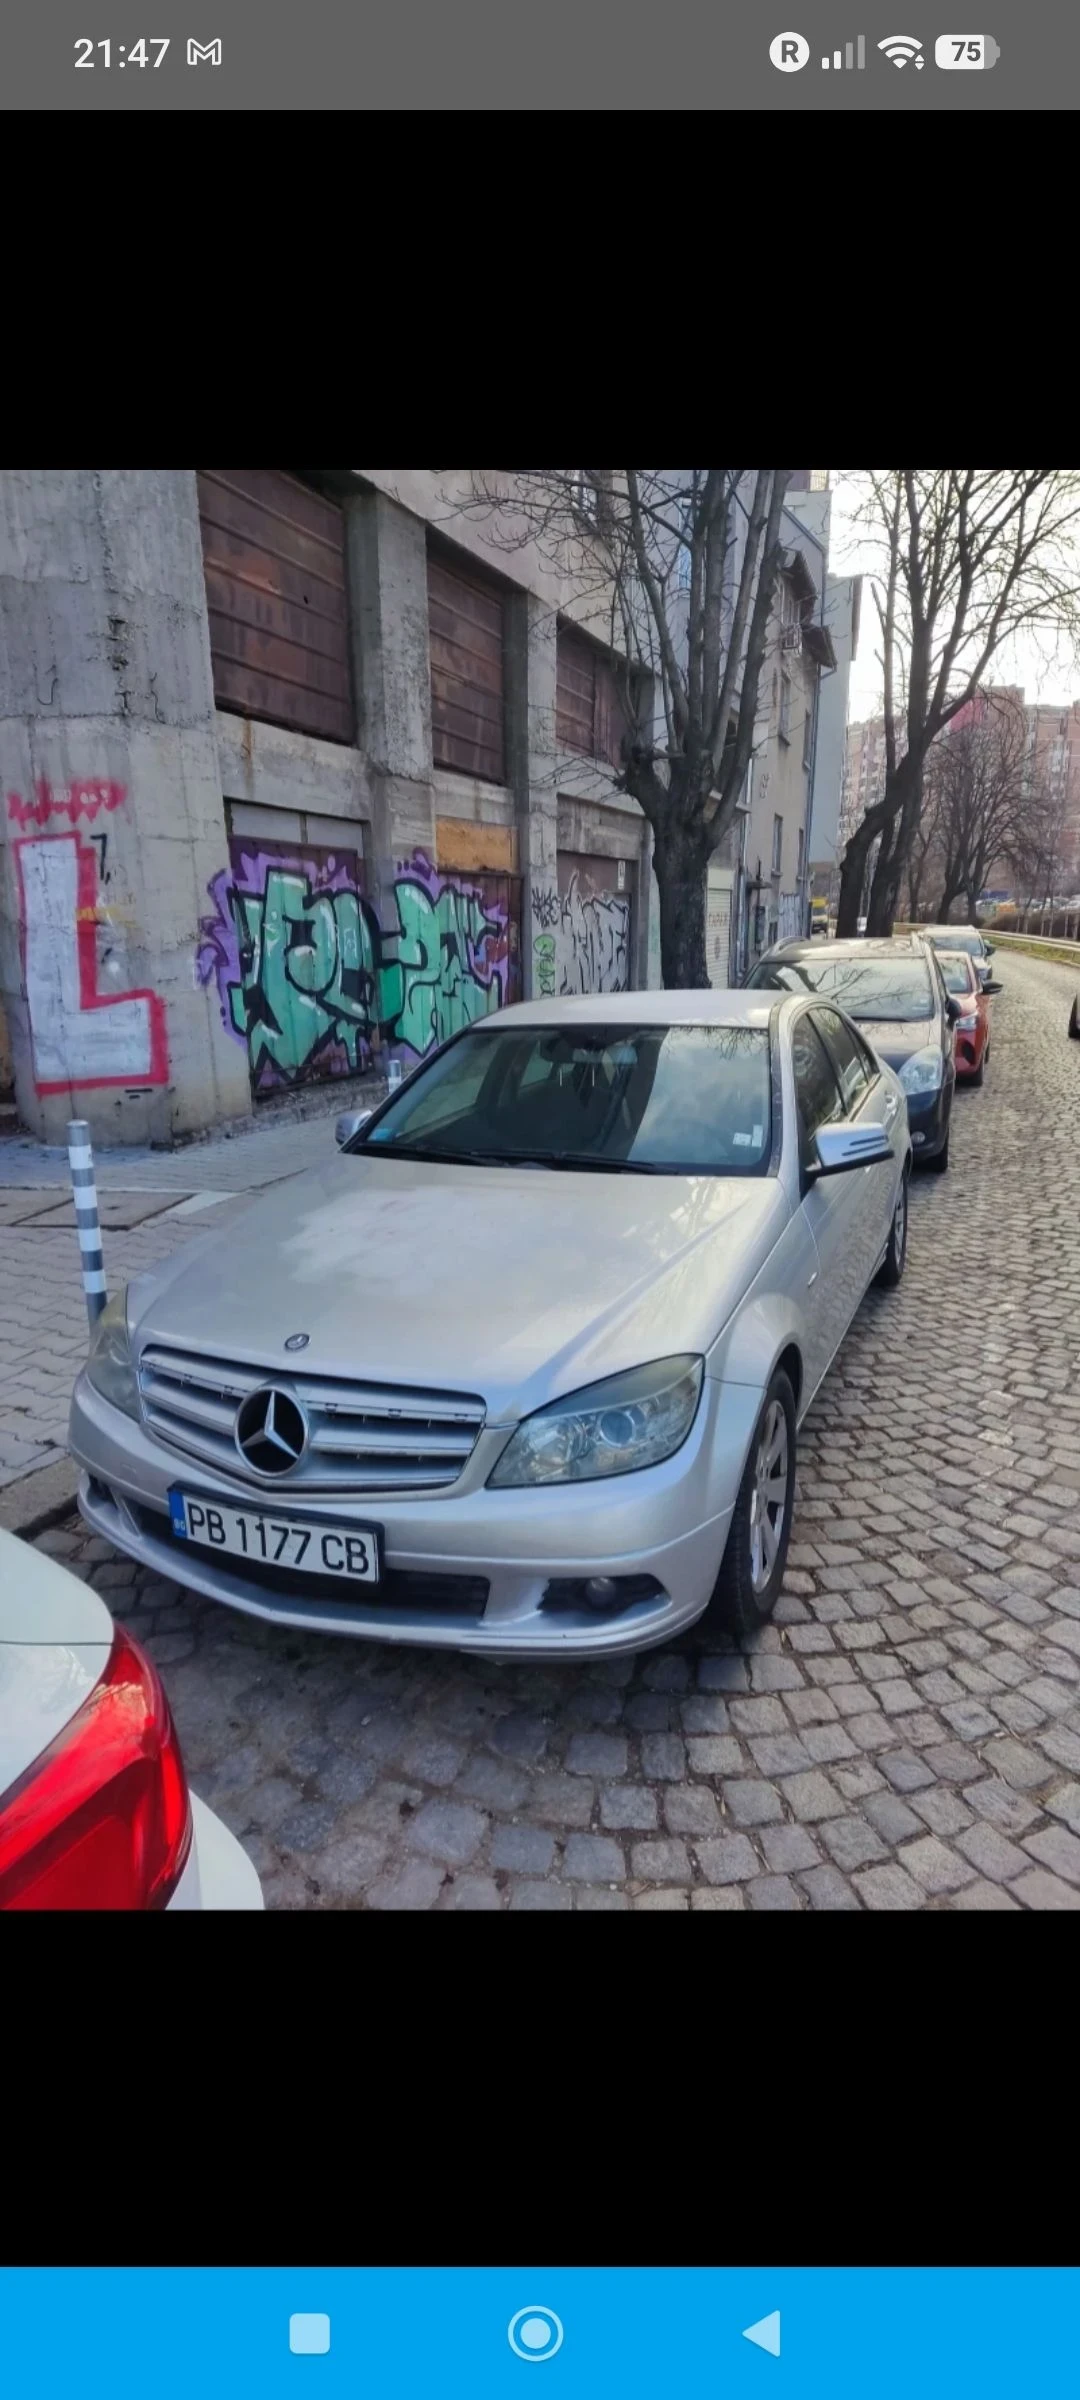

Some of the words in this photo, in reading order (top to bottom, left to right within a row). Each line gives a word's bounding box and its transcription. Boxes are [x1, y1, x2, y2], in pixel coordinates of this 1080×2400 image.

[187, 1503, 226, 1545] PB
[236, 1517, 312, 1565] 1177
[321, 1534, 369, 1575] CB
